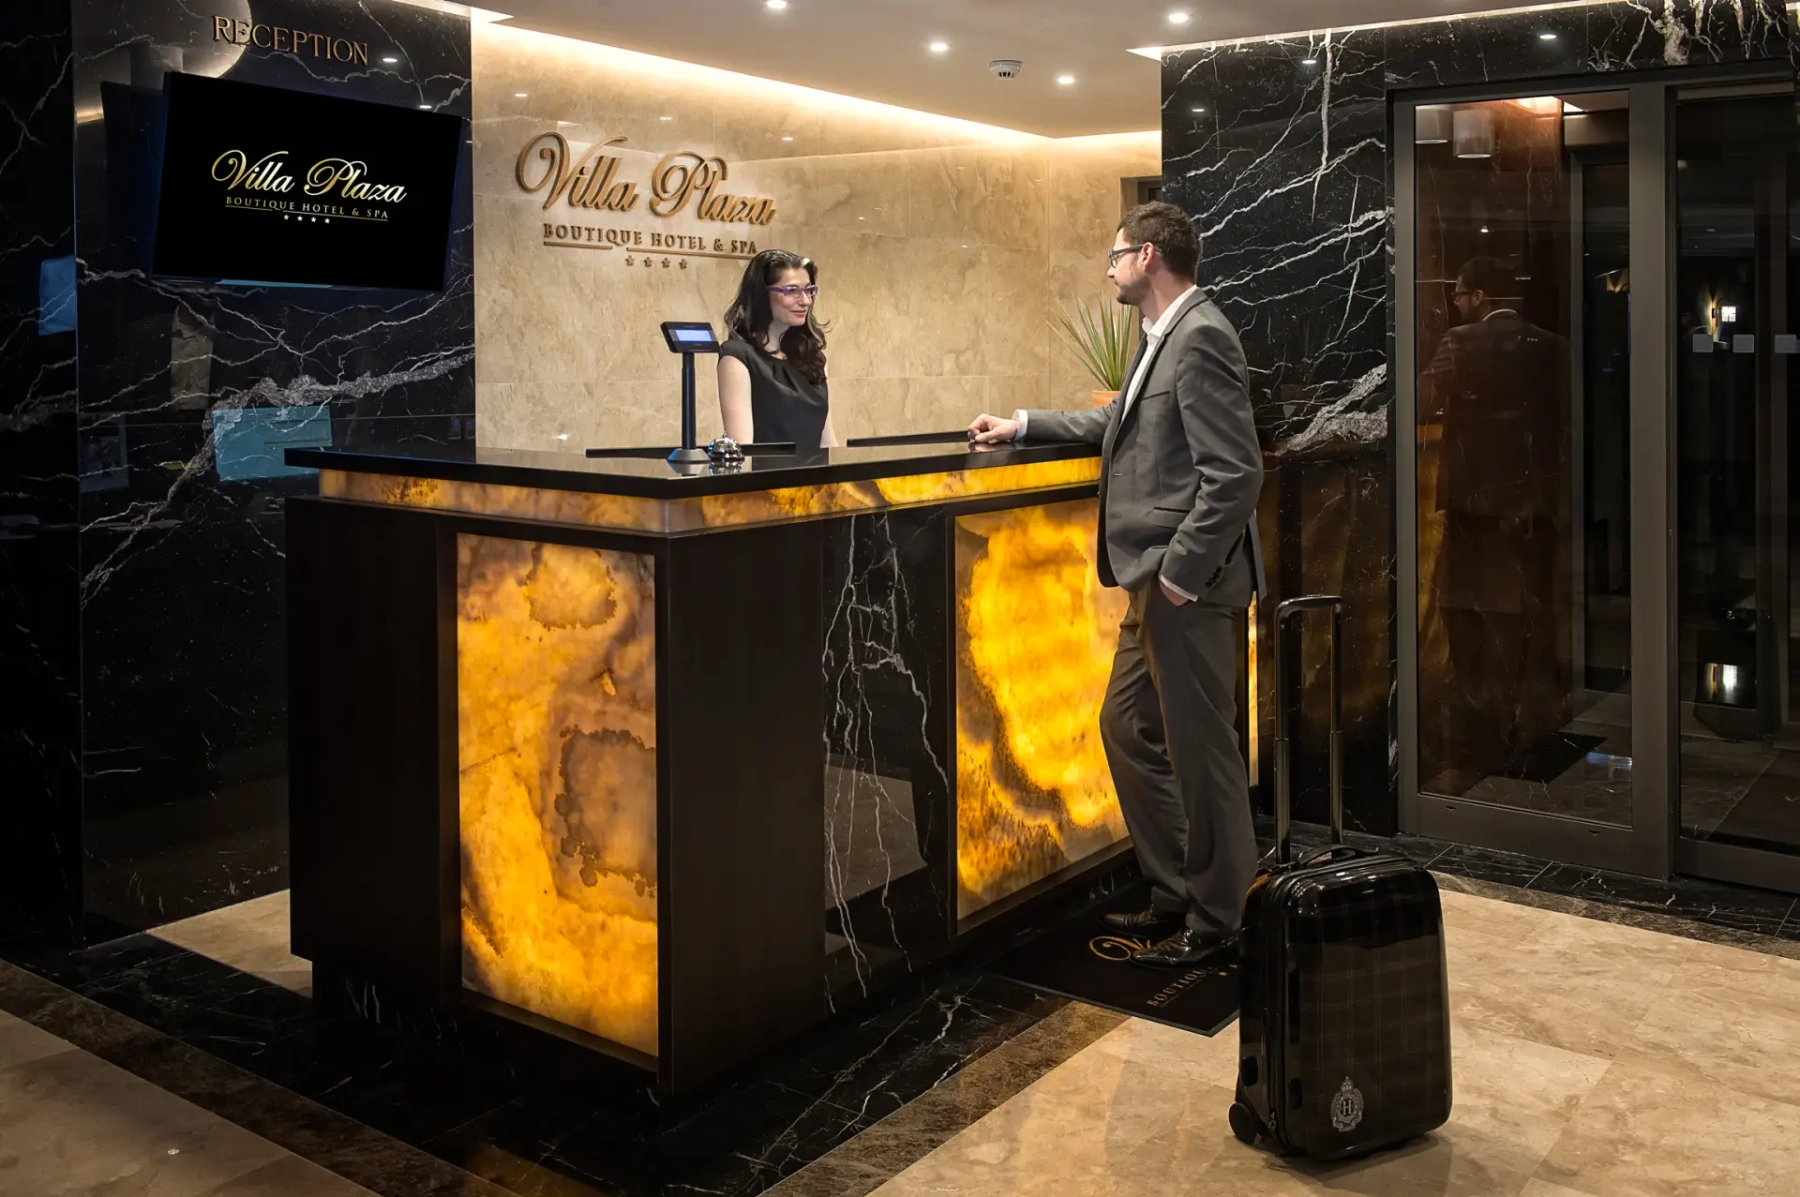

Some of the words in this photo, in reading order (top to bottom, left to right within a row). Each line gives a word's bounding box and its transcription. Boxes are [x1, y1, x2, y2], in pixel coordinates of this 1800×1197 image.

[212, 15, 369, 66] RECEPTION
[211, 149, 295, 193] Villa
[303, 157, 407, 203] Plaza
[515, 131, 641, 211] Villa
[649, 151, 777, 225] Plaza
[225, 196, 296, 211] BOUTIQUE
[302, 203, 345, 215] HOTEL
[351, 207, 360, 217] &
[366, 208, 389, 219] SPA
[543, 222, 643, 247] BOUTIQUE
[651, 232, 707, 251] HOTEL
[713, 238, 724, 252] &
[730, 239, 758, 254] SPA
[1146, 968, 1208, 1007] BOUTIQU
[1342, 1099, 1352, 1116] H
